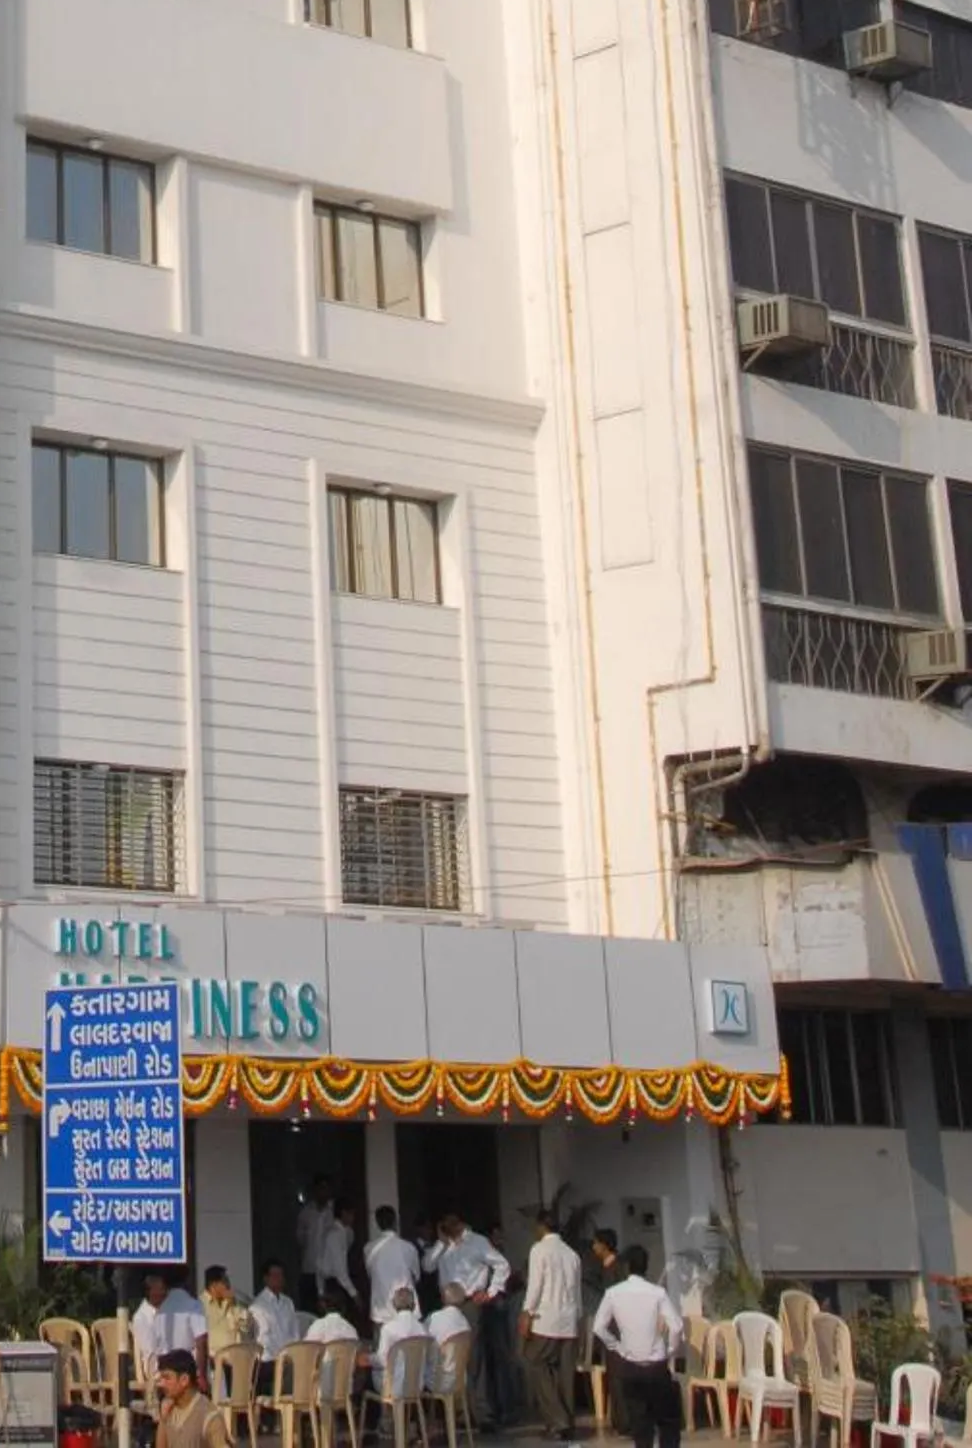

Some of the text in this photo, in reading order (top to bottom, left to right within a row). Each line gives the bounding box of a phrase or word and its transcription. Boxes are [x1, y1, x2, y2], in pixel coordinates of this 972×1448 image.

[55, 918, 175, 960] HOTEL
[56, 972, 319, 1041] INESS
[70, 989, 170, 1016] કતારગામ
[70, 1020, 172, 1046] લાલદરવાજા
[144, 1044, 173, 1076] રોડ
[71, 1098, 110, 1120] વરાછા
[150, 1086, 174, 1119] રોડ
[72, 1128, 101, 1159] સુરત
[136, 1120, 174, 1150] સ્ટેશન
[74, 1149, 174, 1189] સુરત બસ સ્ટેશન
